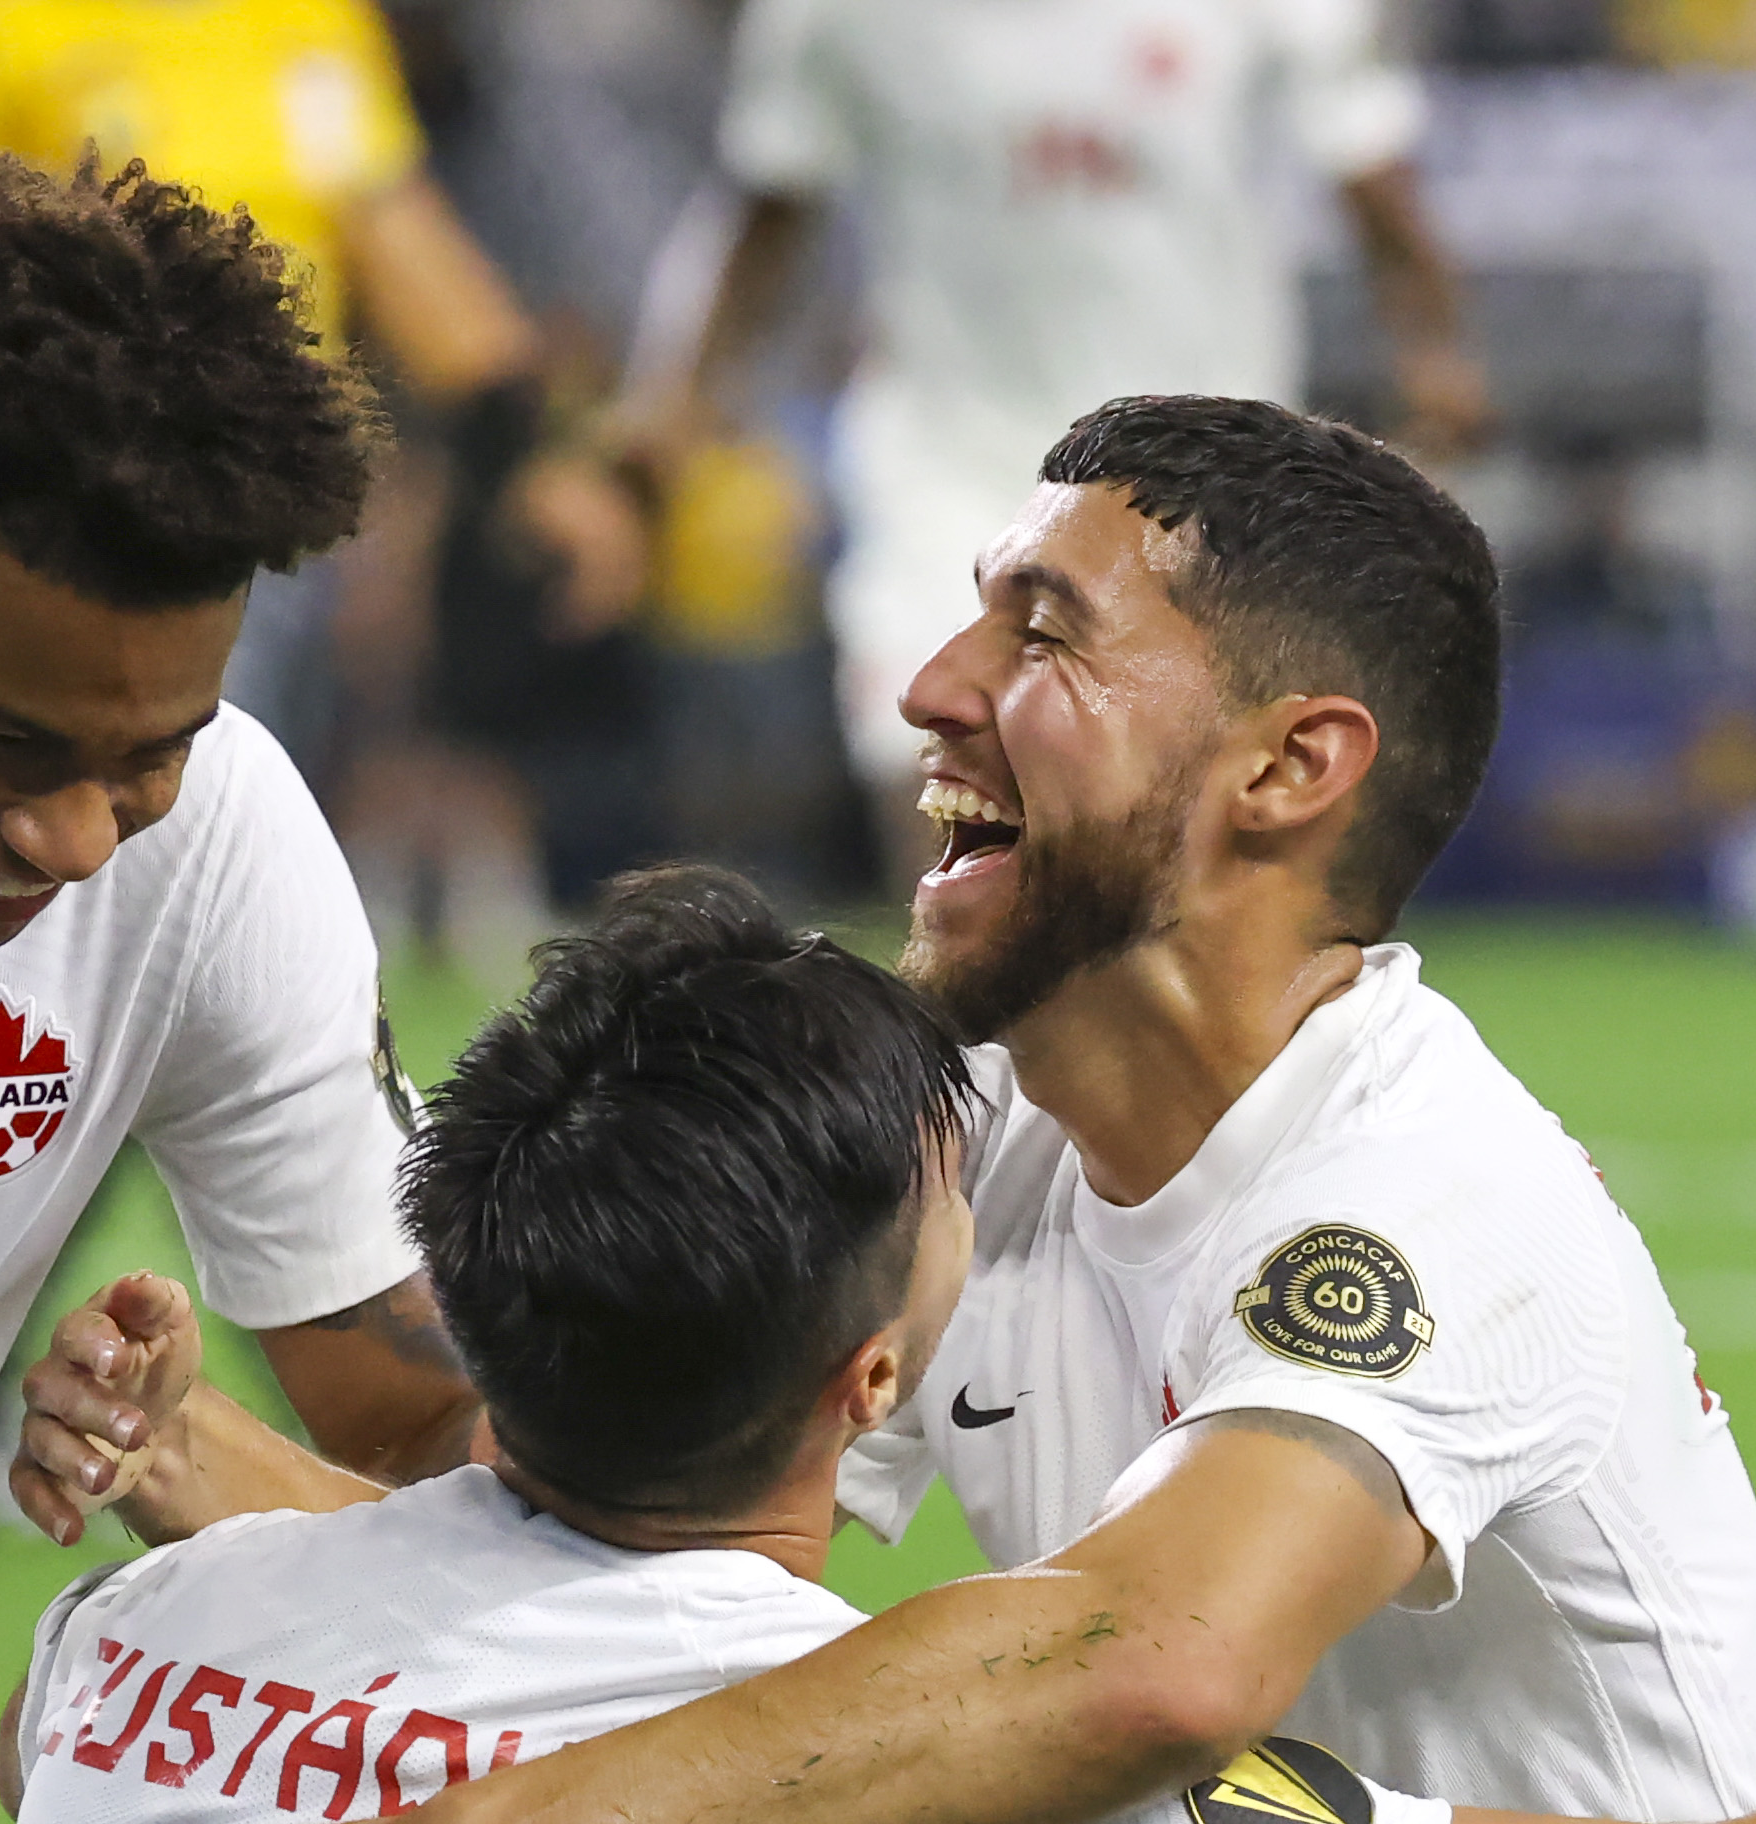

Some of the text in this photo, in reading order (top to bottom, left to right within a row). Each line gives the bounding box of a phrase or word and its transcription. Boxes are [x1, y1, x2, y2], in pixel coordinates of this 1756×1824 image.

[1285, 1235, 1405, 1282] CONCACAF
[1313, 1281, 1364, 1315] 60
[1262, 1318, 1400, 1364] LOVE FOR OUR GAME
